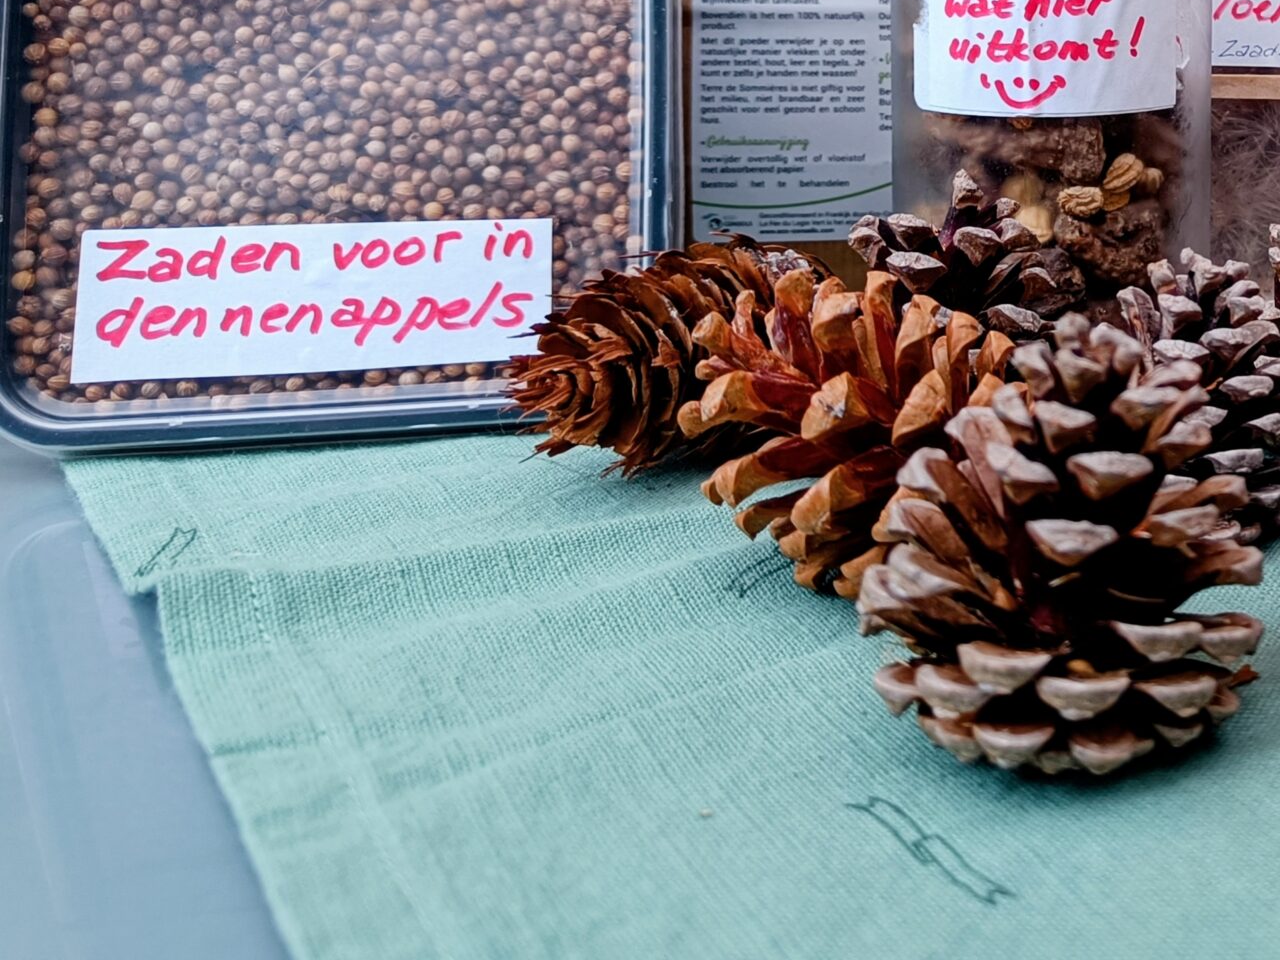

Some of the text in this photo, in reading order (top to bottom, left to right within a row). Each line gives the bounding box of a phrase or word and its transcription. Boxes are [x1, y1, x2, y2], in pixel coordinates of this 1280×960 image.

[798, 12, 821, 20] 100%
[823, 12, 865, 22] natuurlijk
[740, 37, 769, 46] poeder
[775, 37, 814, 46] verwijder
[819, 37, 828, 46] je
[700, 48, 747, 57] natuurlijke
[786, 48, 819, 56] vlekken
[840, 48, 865, 56] onder
[726, 84, 736, 92] de
[801, 84, 818, 92] niet
[820, 84, 843, 94] giftig
[701, 106, 738, 115] geschikt
[784, 106, 816, 115] gezond
[96, 223, 534, 282] Zaden voor in
[96, 281, 534, 348] dennenappels
